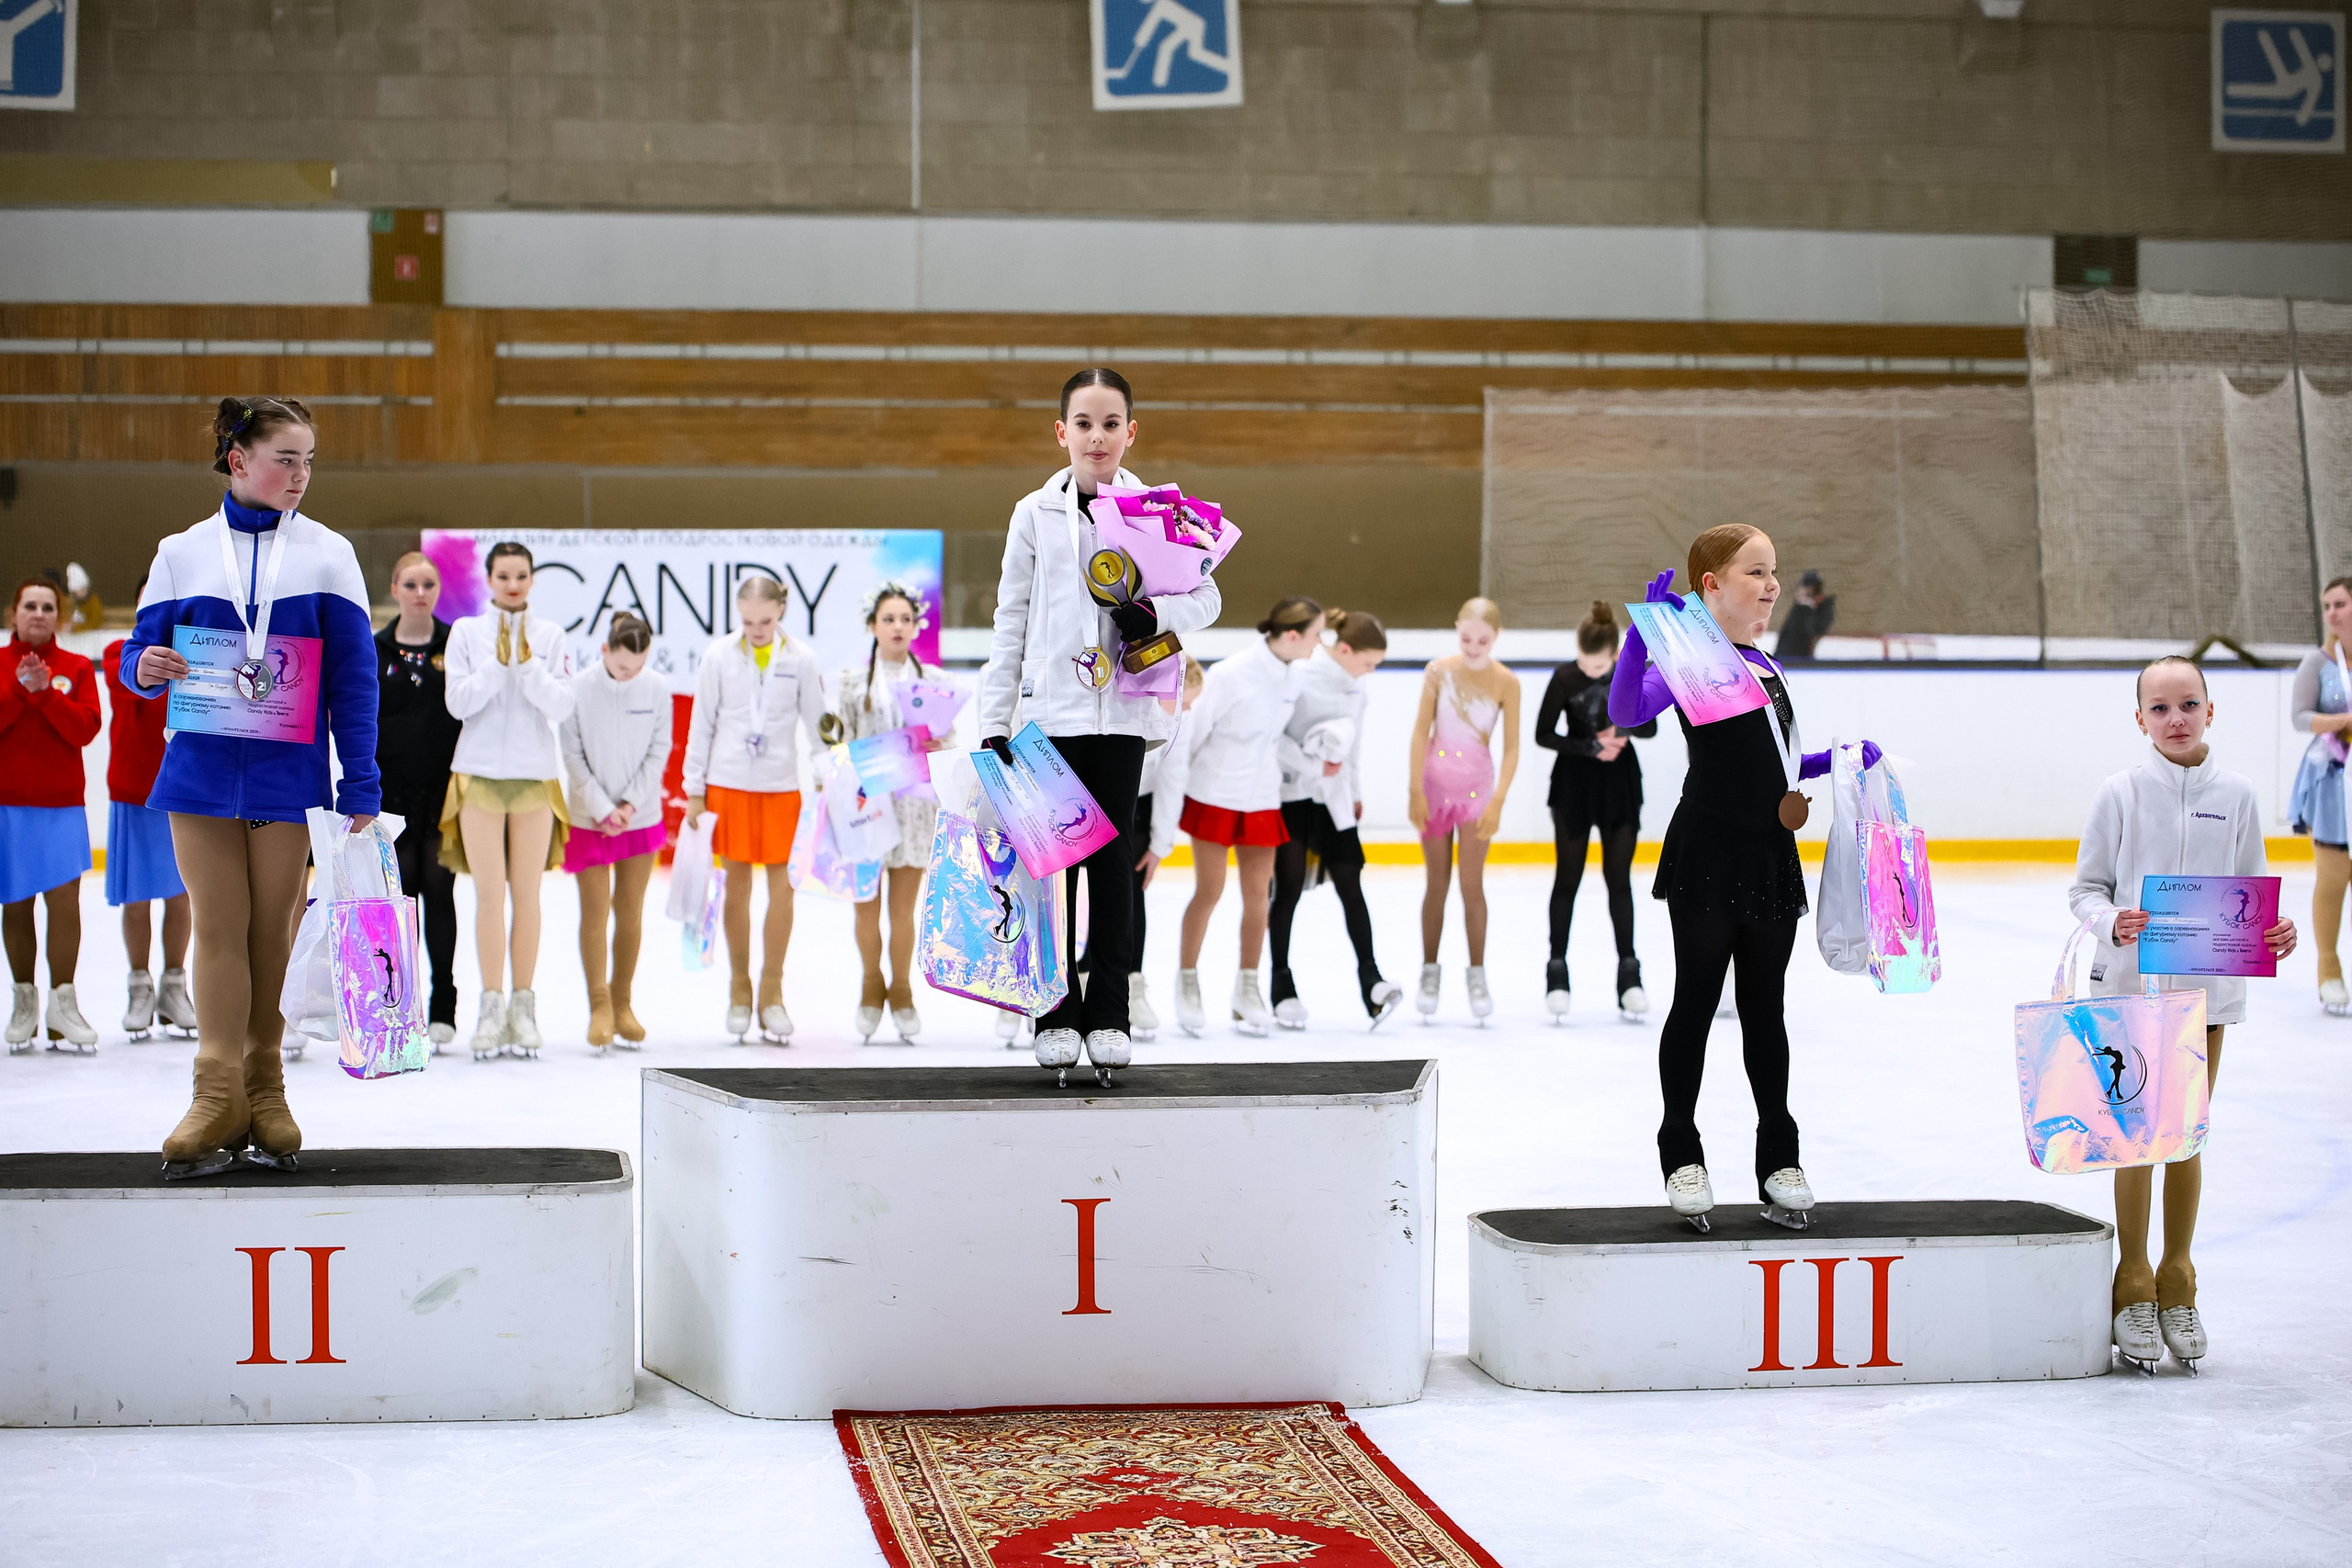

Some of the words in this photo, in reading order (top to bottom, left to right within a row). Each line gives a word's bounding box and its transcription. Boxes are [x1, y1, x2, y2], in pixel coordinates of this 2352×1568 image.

[531, 561, 838, 636] CANDY
[280, 676, 304, 692] CANDY
[2195, 811, 2226, 820] Архангельск
[1055, 834, 1079, 848] CANDY
[2243, 913, 2264, 930] CANDY
[2121, 1107, 2145, 1115] CANDY
[235, 1247, 346, 1365] II
[1748, 1255, 1904, 1371] III
